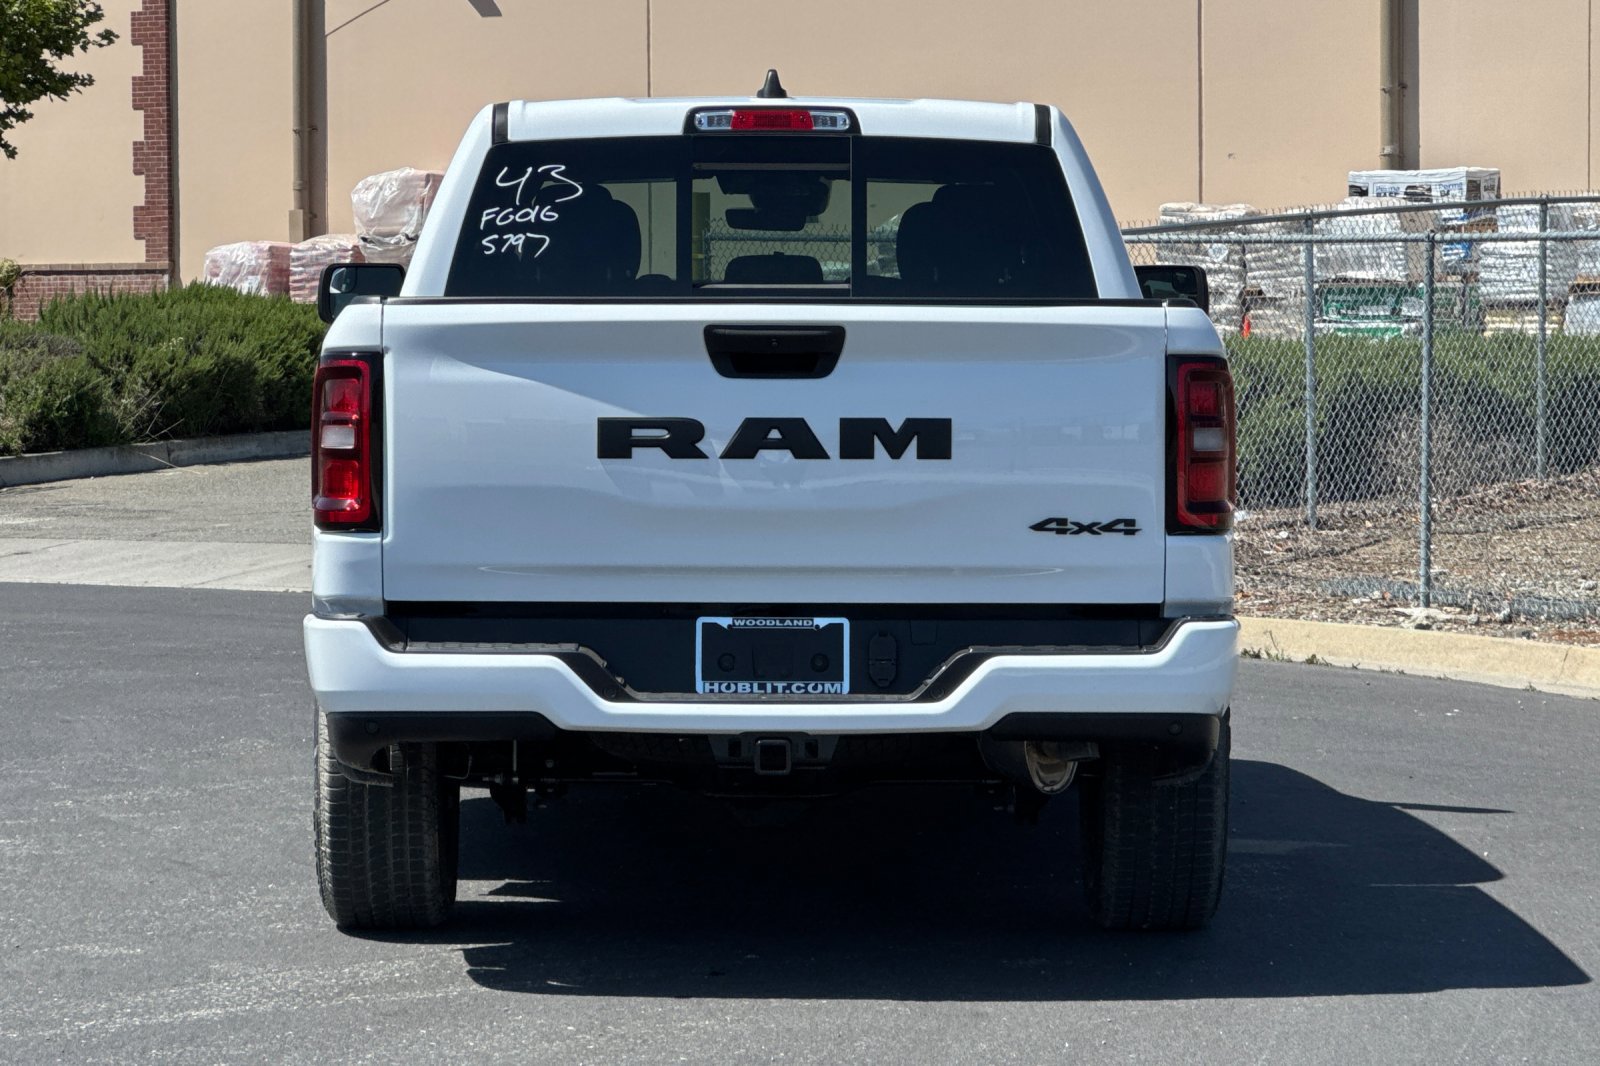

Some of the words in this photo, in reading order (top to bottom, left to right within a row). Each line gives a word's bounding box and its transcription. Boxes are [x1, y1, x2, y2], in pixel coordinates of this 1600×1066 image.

[496, 164, 583, 205] 43
[597, 417, 952, 459] RAM
[1028, 517, 1142, 535] 4x4
[733, 619, 813, 627] WOODLAND
[704, 682, 842, 694] HOBLIT.COM
